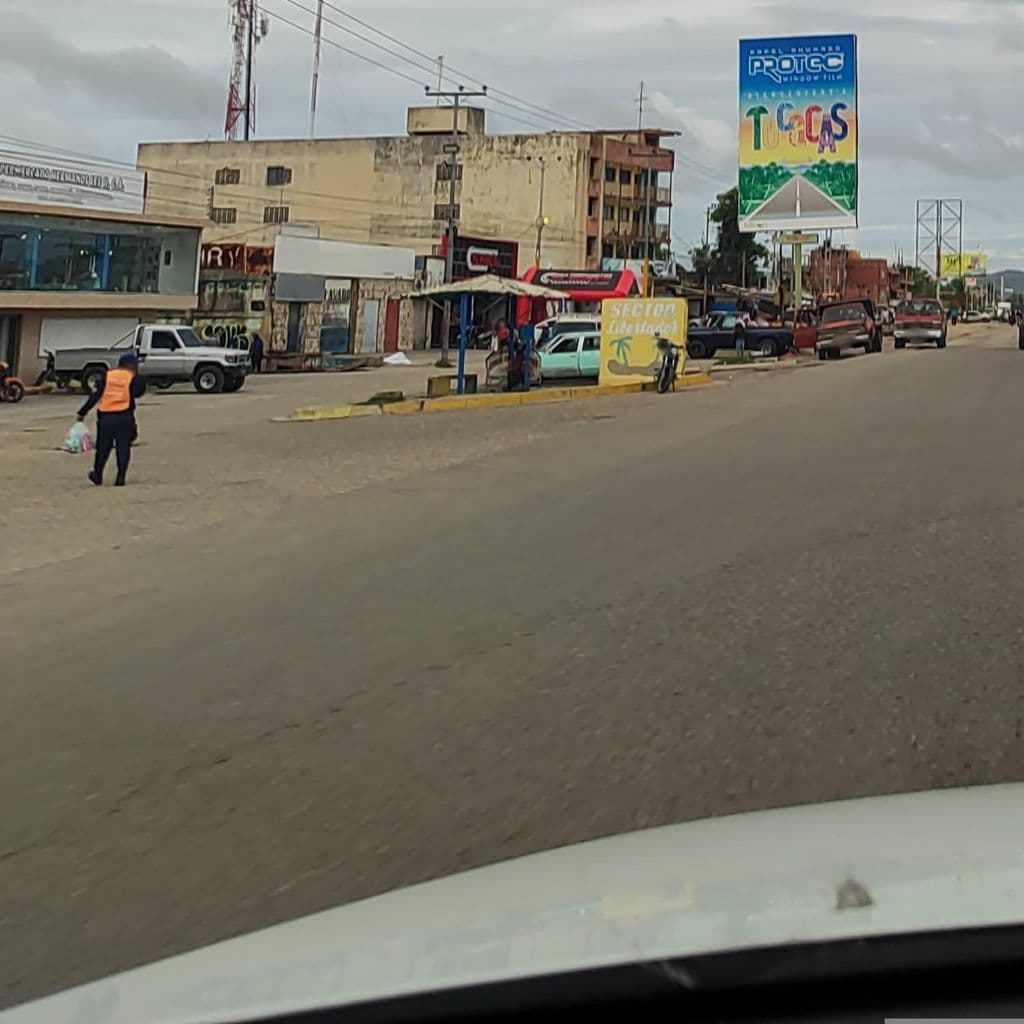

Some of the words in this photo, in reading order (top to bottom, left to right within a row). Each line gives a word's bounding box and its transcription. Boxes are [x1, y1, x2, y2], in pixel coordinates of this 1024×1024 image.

[748, 53, 845, 83] PROTEC
[746, 102, 849, 154] TUCACAS
[610, 302, 676, 318] SECTOR
